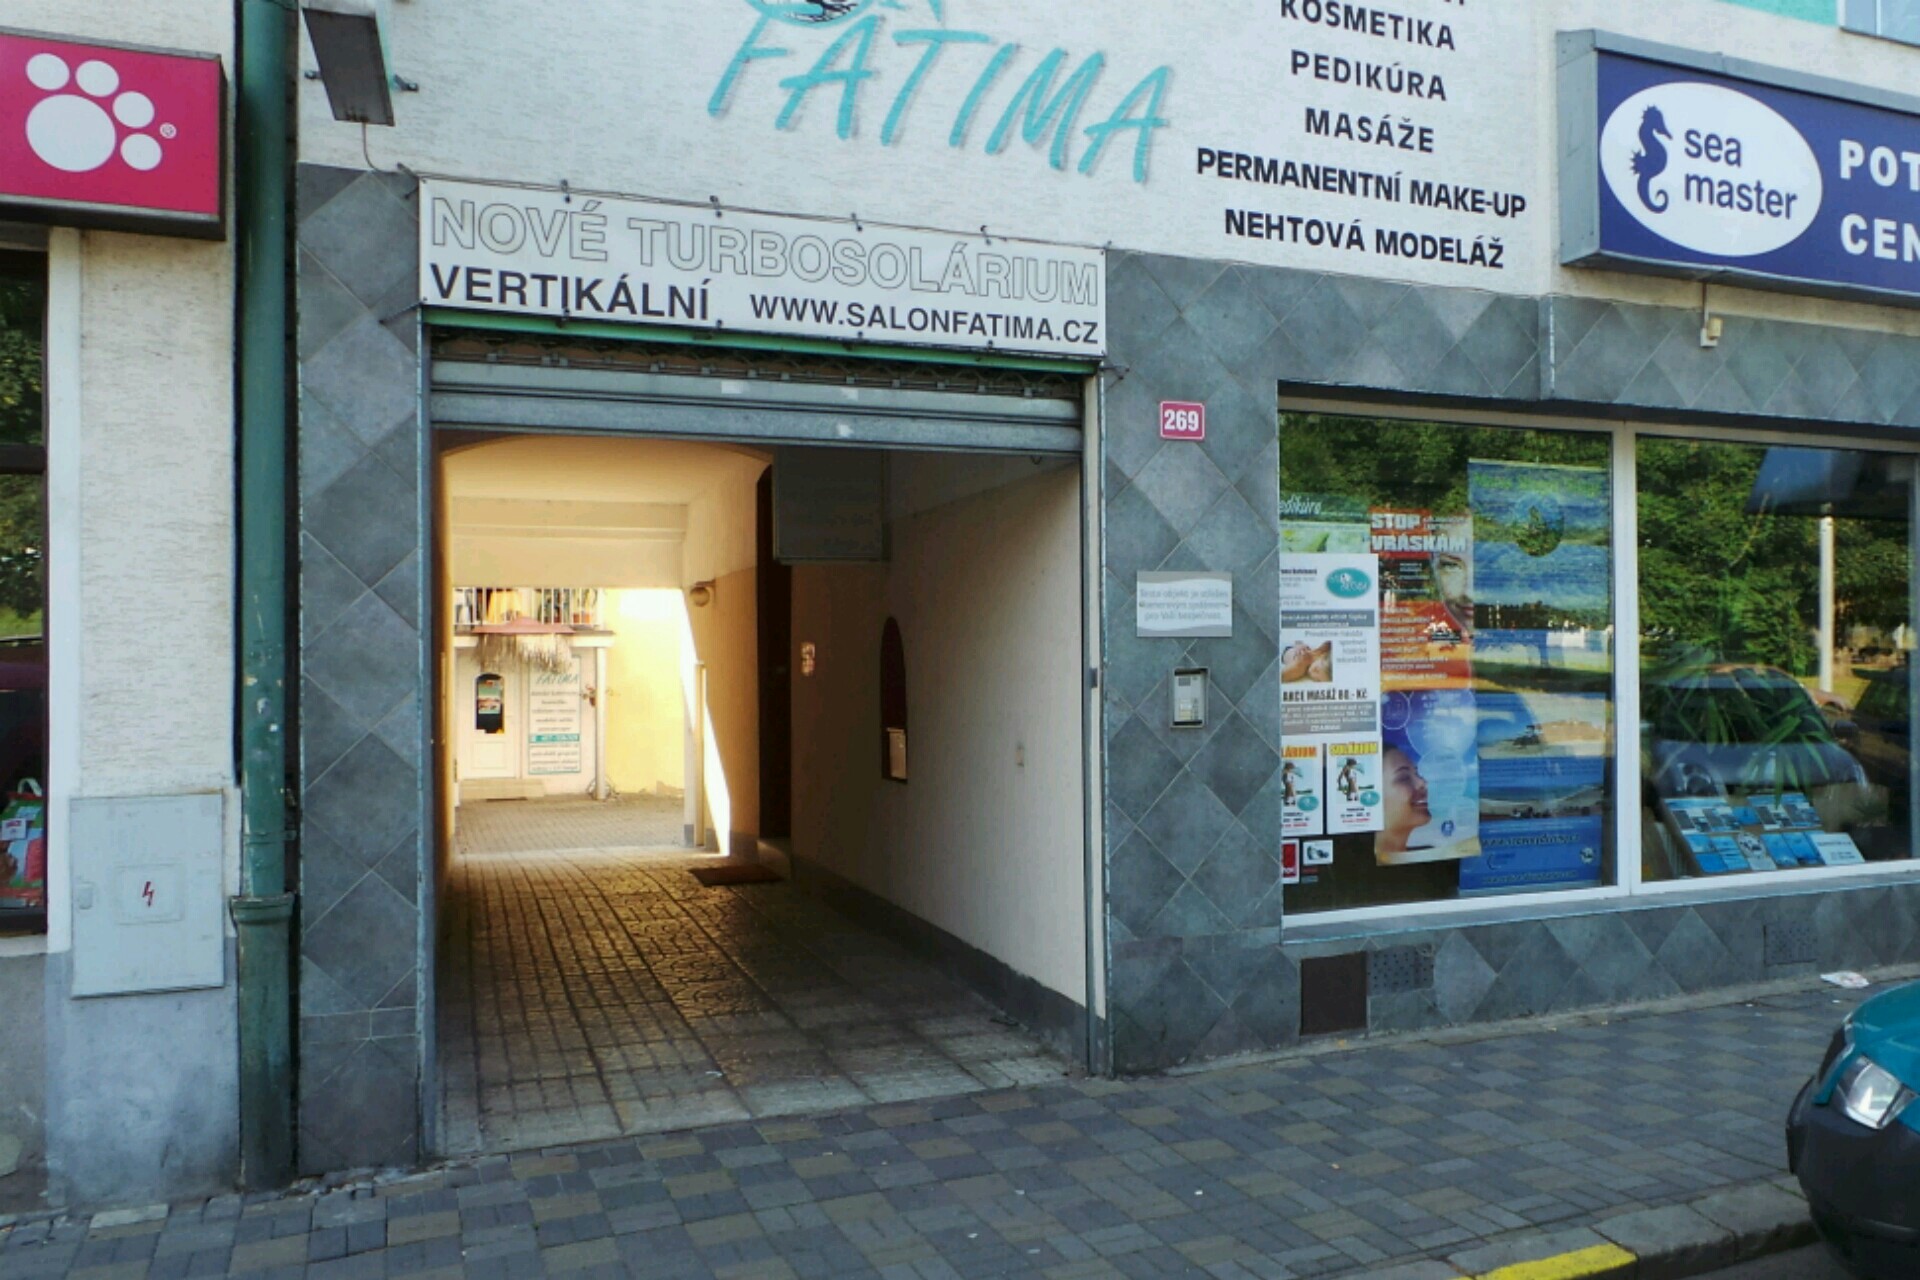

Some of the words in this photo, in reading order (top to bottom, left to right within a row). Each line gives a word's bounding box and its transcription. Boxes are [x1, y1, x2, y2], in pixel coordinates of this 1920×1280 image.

[1281, 0, 1456, 50] KOSMETIKA
[706, 13, 1173, 184] FATIMA
[1290, 49, 1447, 101] PEDIKÚRA
[1304, 107, 1435, 153] MASÁŽE
[1684, 128, 1741, 168] sea
[1197, 147, 1402, 203] PERMANENTNÍ
[1409, 179, 1526, 219] MAKE-UP
[1684, 173, 1798, 220] master
[431, 197, 608, 262] NOVÉ
[627, 216, 1098, 307] TURBOSOLÁRIUM
[1225, 208, 1365, 252] NEHTOVÁ
[1375, 228, 1504, 269] MODELÁŽ
[430, 263, 712, 321] VERTIKÁLNÍ
[749, 294, 1099, 345] WWW.SALONFATIMA.CZ
[1163, 409, 1200, 432] 269
[1371, 513, 1420, 529] STOP
[1371, 533, 1467, 551] VRÁSKÁM
